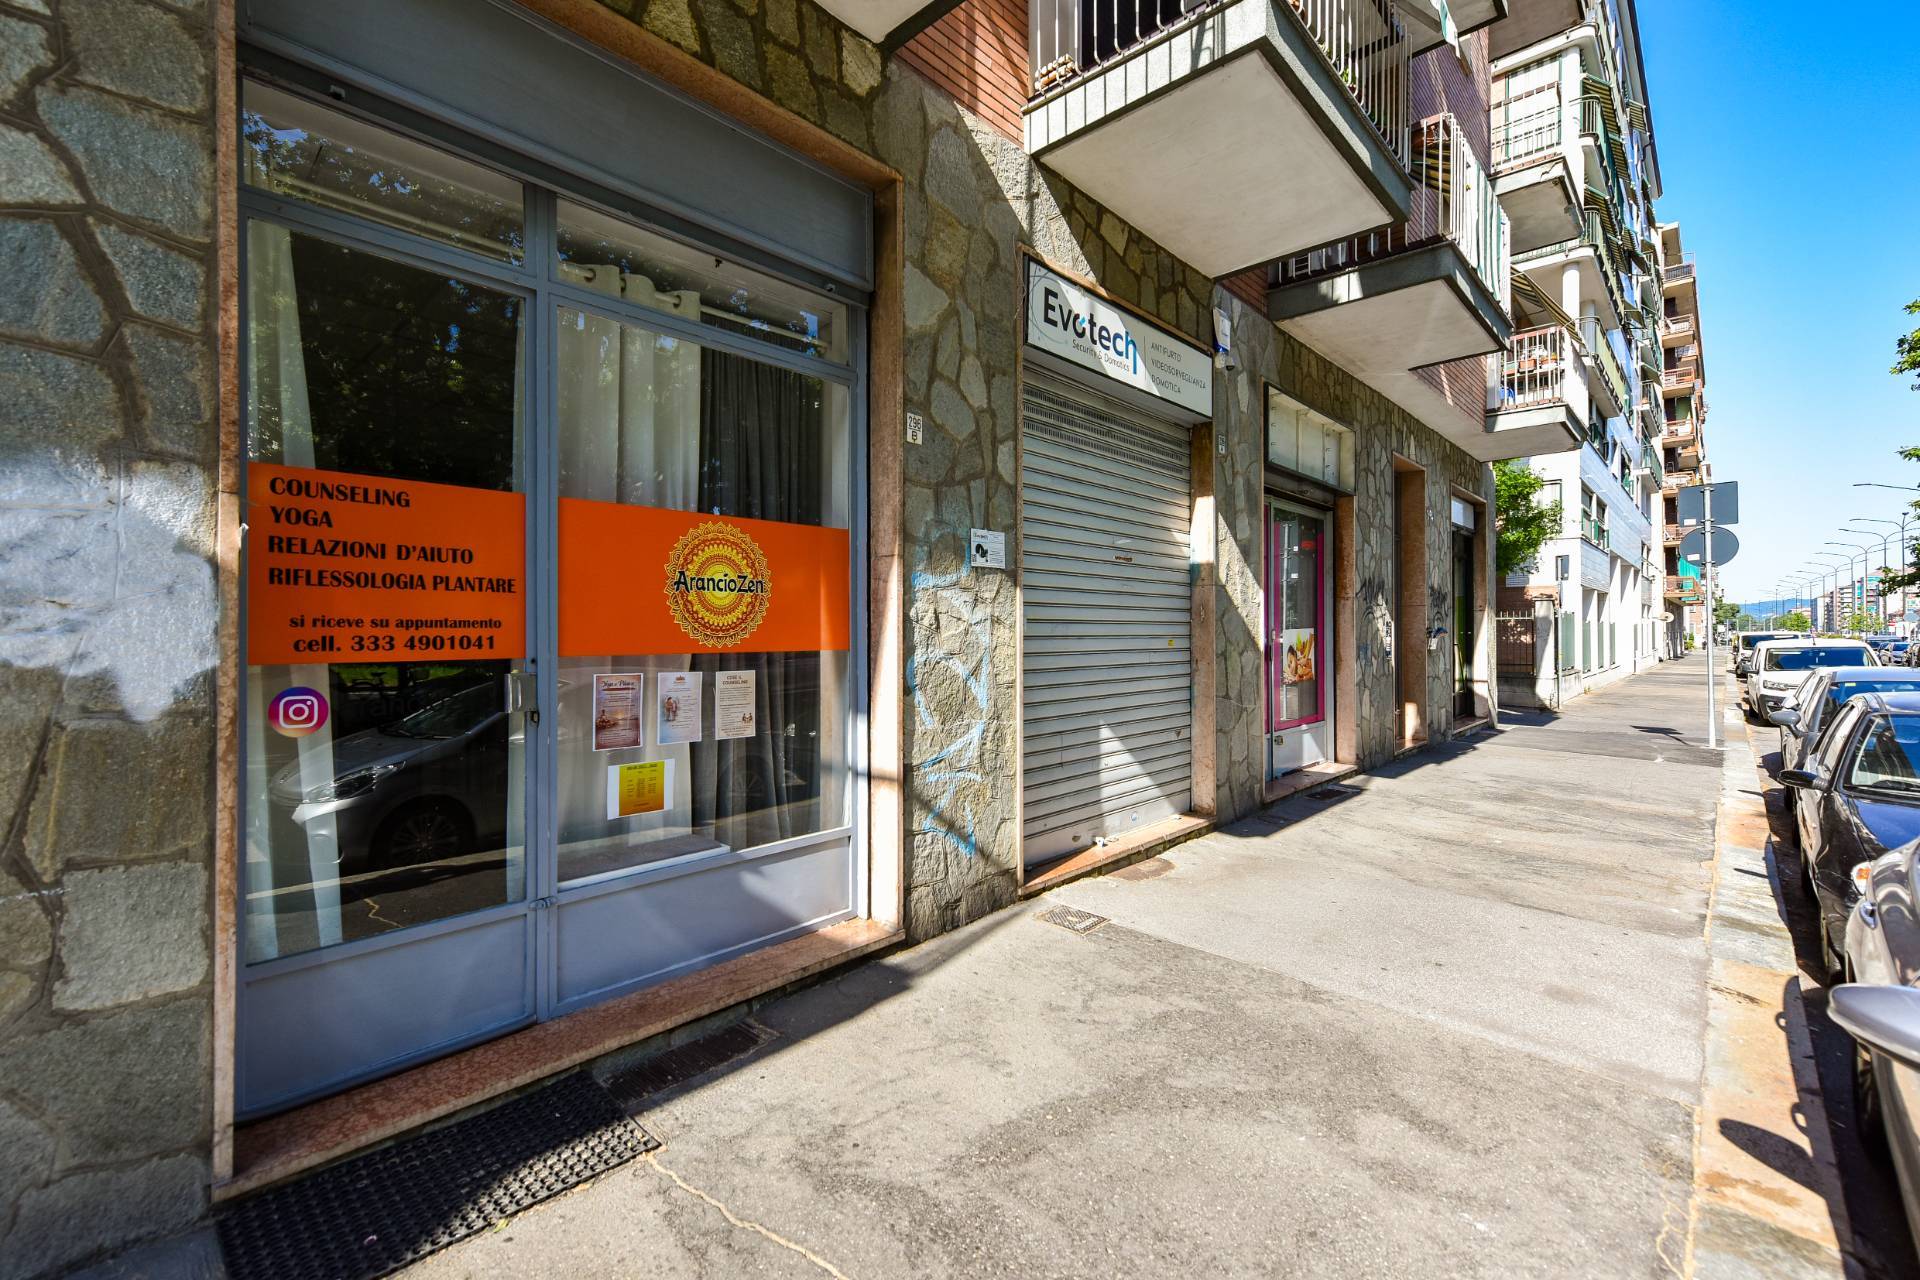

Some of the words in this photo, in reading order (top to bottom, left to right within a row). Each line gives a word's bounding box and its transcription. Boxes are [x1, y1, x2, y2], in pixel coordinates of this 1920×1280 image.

[1043, 286, 1137, 375] Evotech
[1072, 338, 1098, 359] Security
[1150, 341, 1182, 362] ANTIFURTO
[1151, 358, 1206, 389] VIDEOSORVEGLIANZA
[1151, 374, 1182, 394] DOMOTICA
[269, 476, 411, 508] COUNSELING
[270, 506, 334, 528] YOGA
[268, 535, 386, 560] RELAZIONI
[396, 544, 474, 565] D'AIUTO
[268, 567, 426, 591] RIFLESSOLOGIA
[432, 575, 517, 594] PLANTARE
[674, 570, 765, 594] ArancioZen
[289, 615, 305, 628] si
[311, 615, 364, 628] riceve
[370, 616, 390, 628] su
[395, 617, 502, 631] appuntamento
[293, 635, 341, 652] cell.
[351, 635, 395, 651] 333
[404, 635, 495, 651] 4901041
